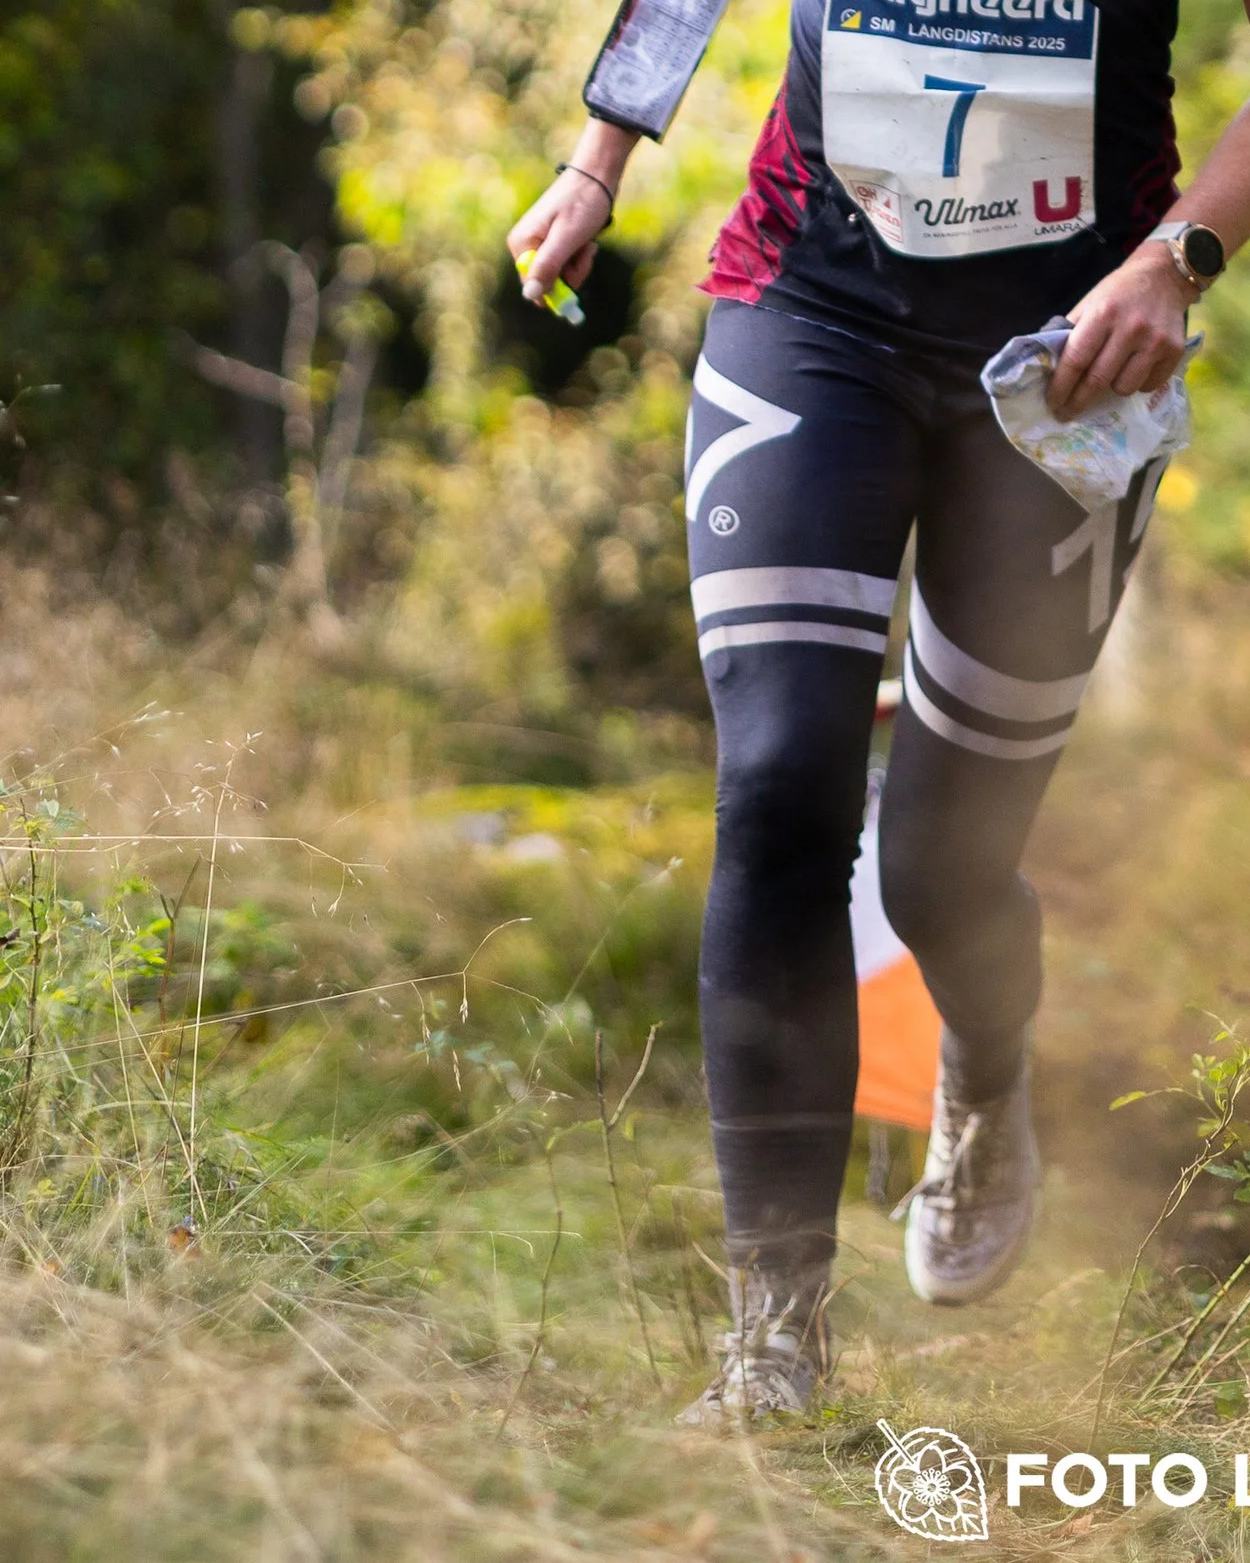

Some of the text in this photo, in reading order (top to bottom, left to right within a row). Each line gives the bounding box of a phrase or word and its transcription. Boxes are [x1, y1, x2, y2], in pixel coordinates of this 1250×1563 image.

[869, 15, 897, 33] SM
[1027, 36, 1067, 51] 2025
[923, 73, 987, 179] 7
[914, 197, 1019, 227] Ullmax
[1033, 222, 1083, 237] UMARA
